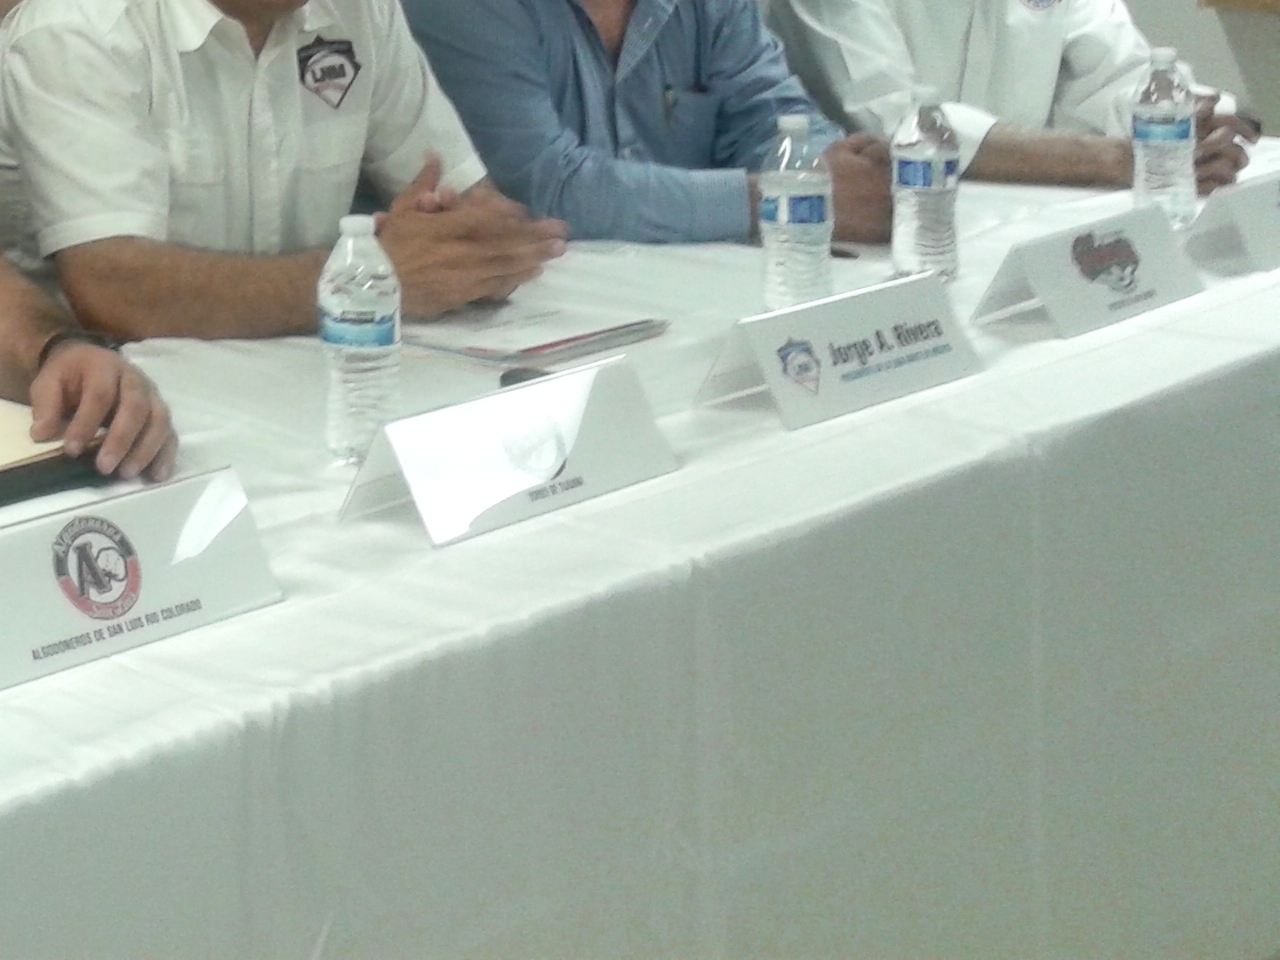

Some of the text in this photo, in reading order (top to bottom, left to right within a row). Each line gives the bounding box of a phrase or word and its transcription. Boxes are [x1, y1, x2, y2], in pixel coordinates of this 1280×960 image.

[827, 340, 876, 367] Jorge
[874, 328, 895, 352] A.
[891, 319, 945, 348] Rivera
[31, 632, 94, 660] ALGODONEROS
[93, 627, 107, 641] DE
[106, 623, 126, 639] SAN
[124, 616, 145, 633] LUIS
[160, 598, 203, 621] COLORADO
